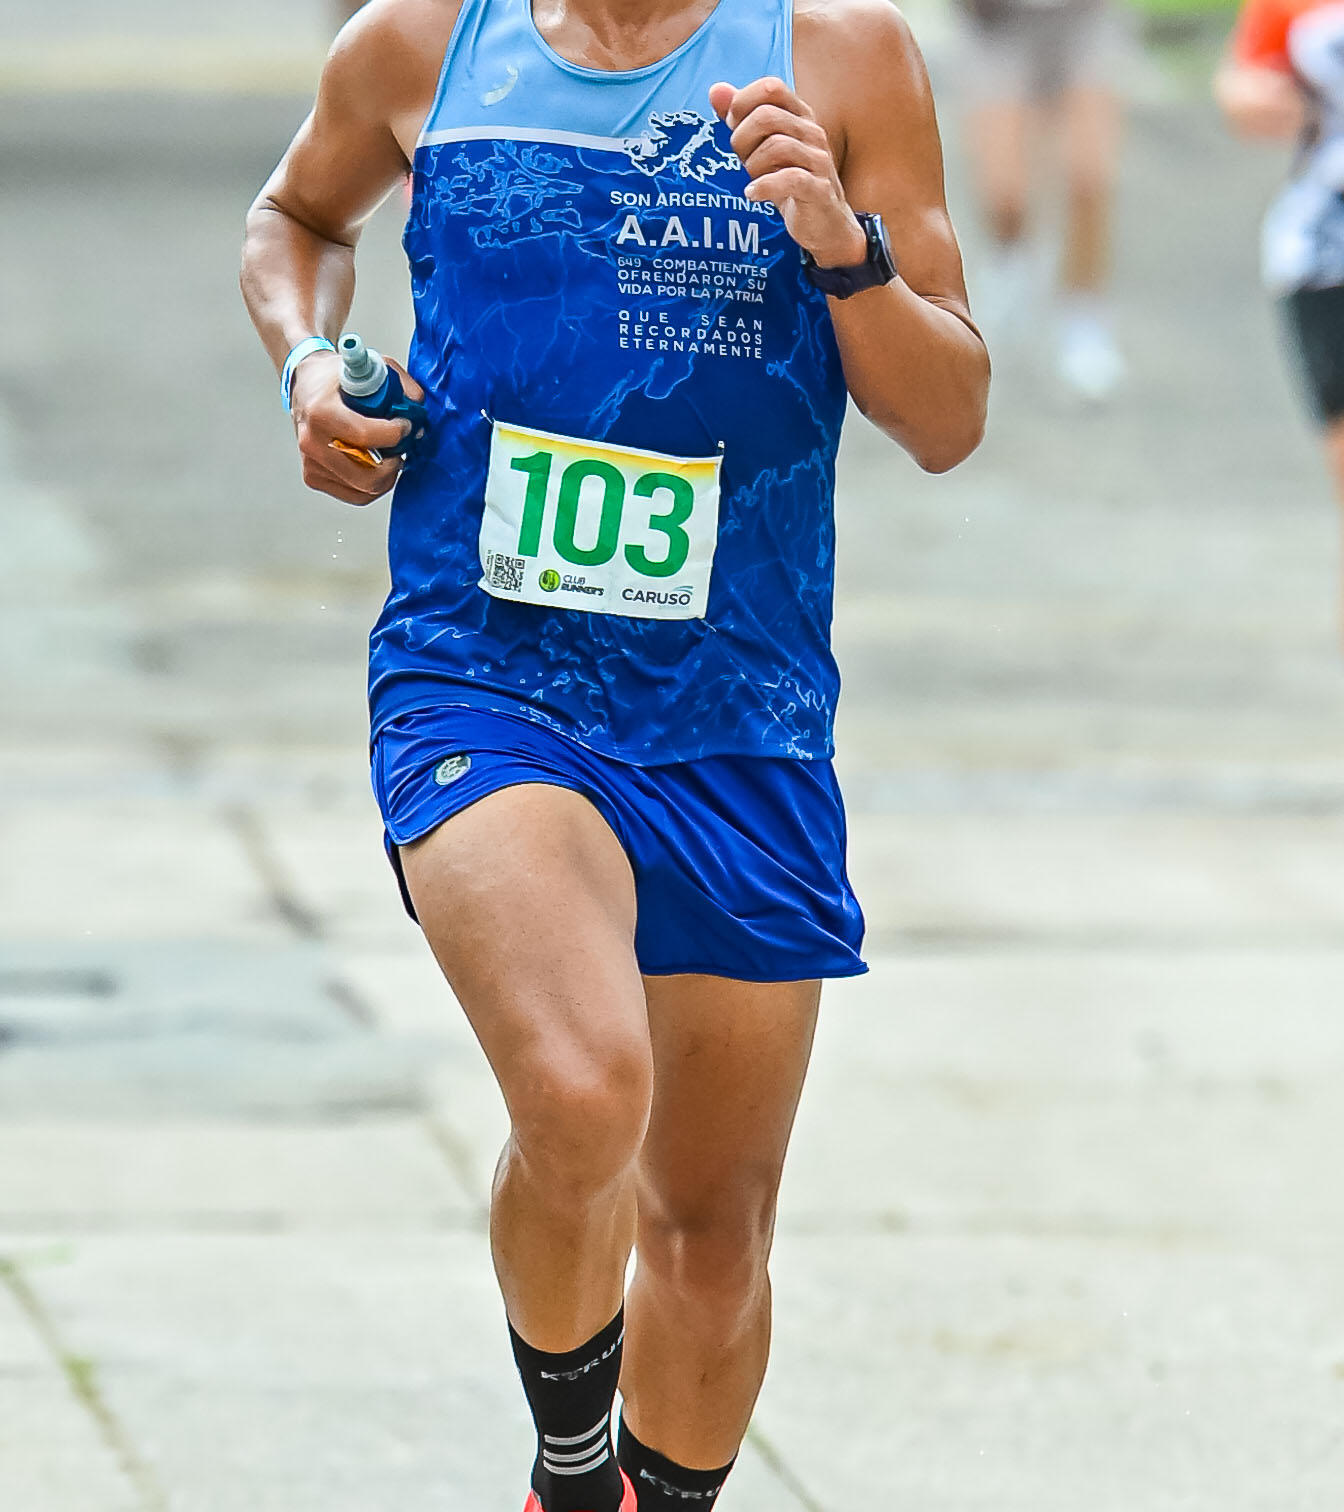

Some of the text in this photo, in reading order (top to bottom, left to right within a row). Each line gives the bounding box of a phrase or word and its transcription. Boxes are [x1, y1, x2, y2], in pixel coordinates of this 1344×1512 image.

[610, 190, 775, 216] SON ARGENTINAS
[616, 214, 769, 256] A.A.I.M.
[617, 256, 768, 278] 649 COMBATIENTES
[617, 269, 766, 291] OFRENDARON SU
[617, 282, 764, 304] VIDA POR LA PATRIA
[618, 309, 763, 331] QUE SEAN
[619, 323, 763, 346] RECORDADOS
[619, 337, 763, 360] ETERNAMENTE
[509, 450, 695, 579] 103
[563, 574, 586, 585] CLUB
[622, 588, 691, 606] CARUSO
